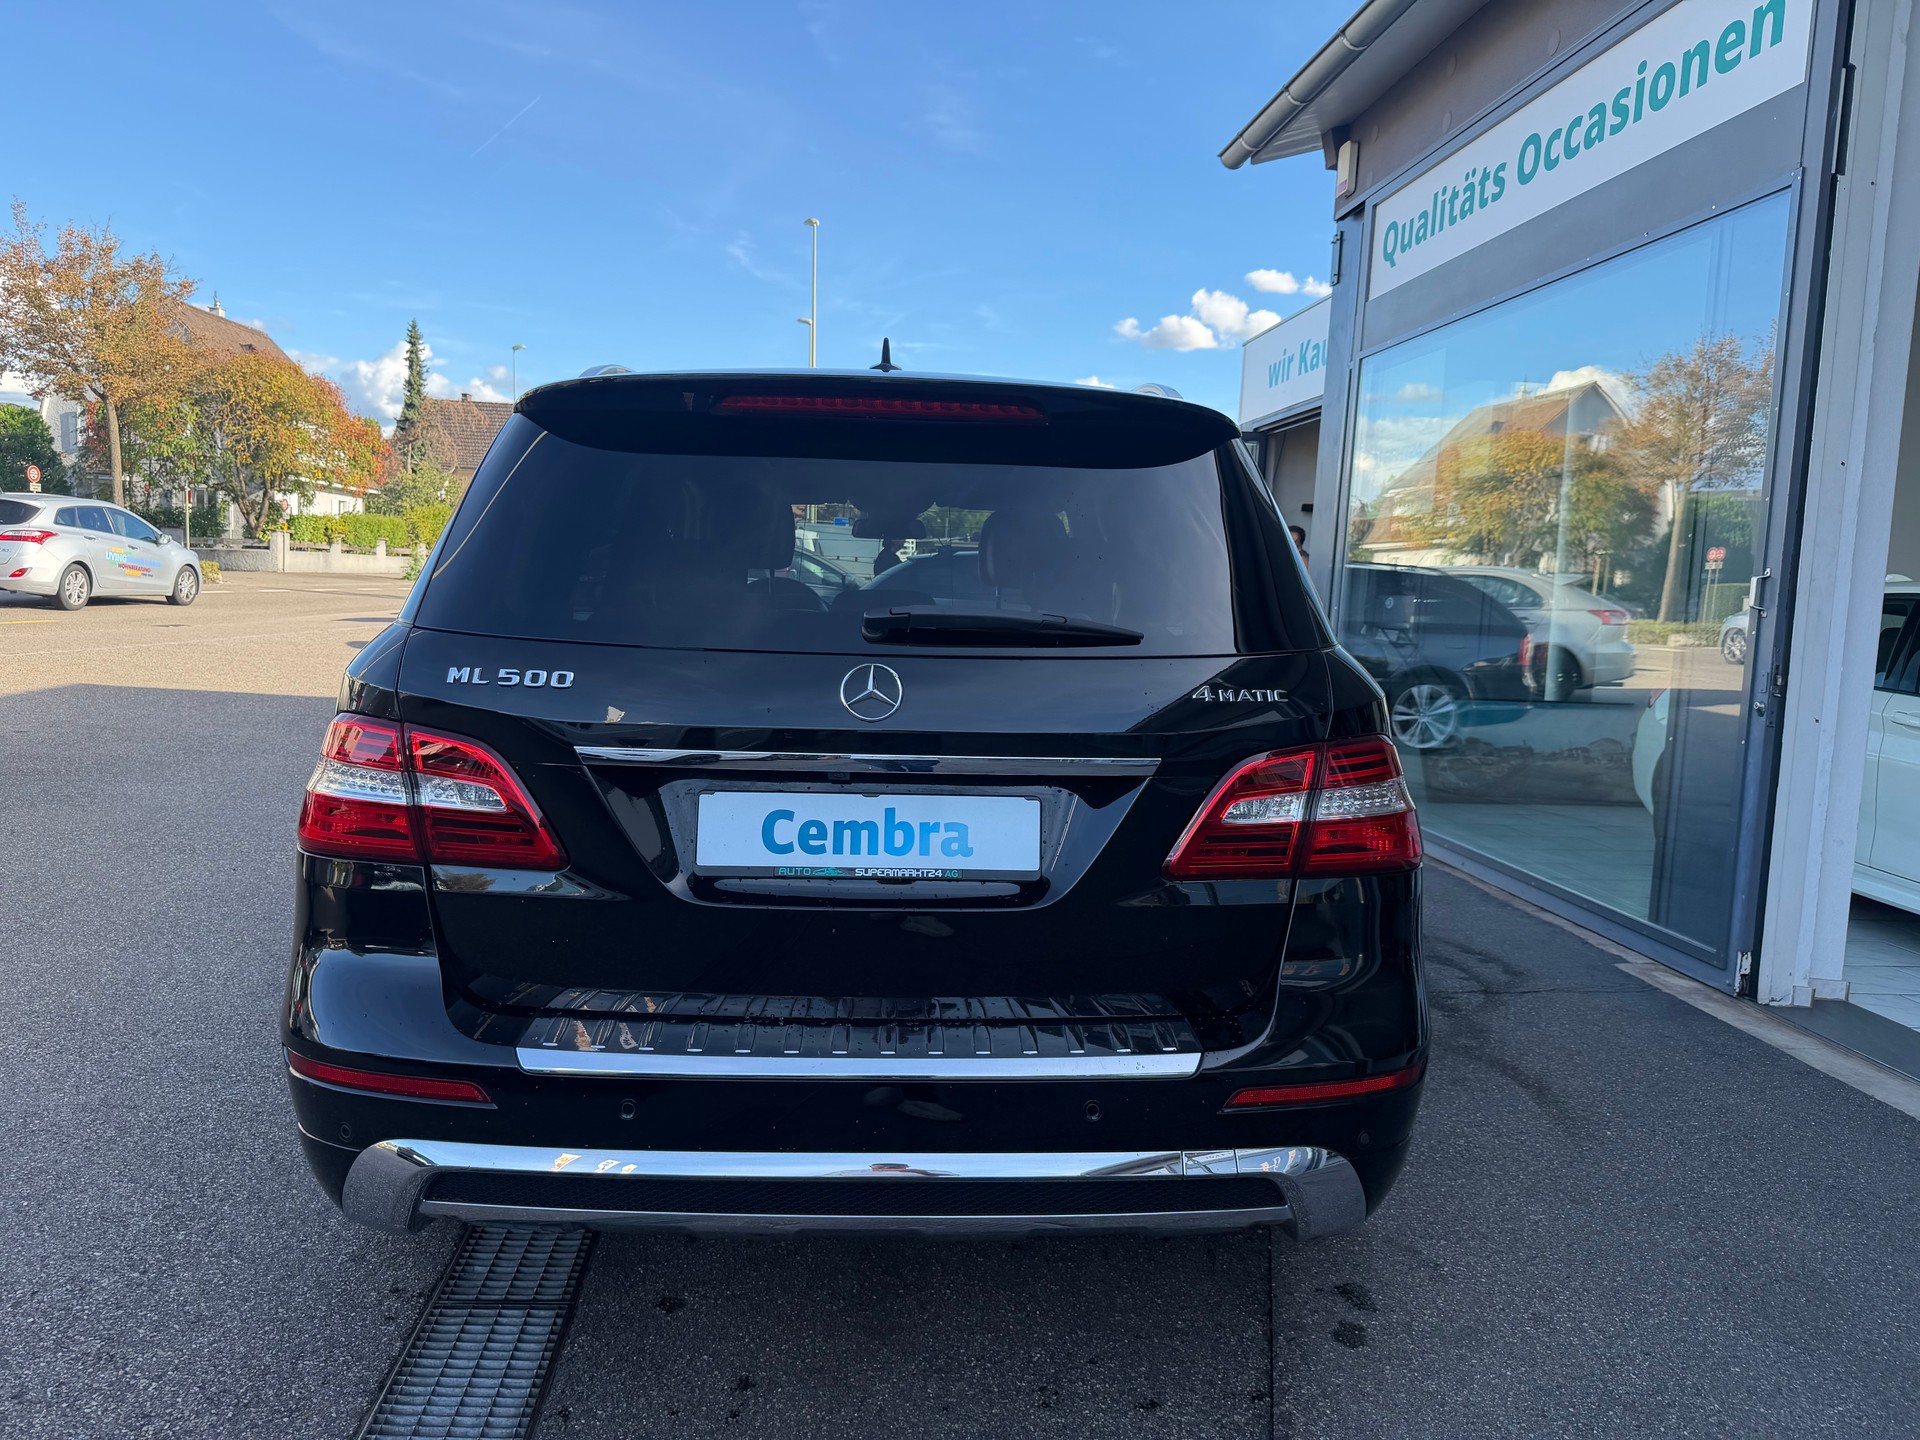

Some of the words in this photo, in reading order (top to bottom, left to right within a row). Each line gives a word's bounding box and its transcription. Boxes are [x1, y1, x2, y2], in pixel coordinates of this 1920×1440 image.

[1382, 161, 1507, 268] Qualitäts
[1516, 0, 1786, 186] Occasionen
[1268, 348, 1295, 389] wir
[446, 666, 490, 685] ML
[497, 668, 575, 688] 500
[761, 807, 974, 858] Cembra
[778, 867, 812, 876] AUTO
[855, 868, 943, 878] SUPERMARKT24
[944, 870, 959, 878] AG
